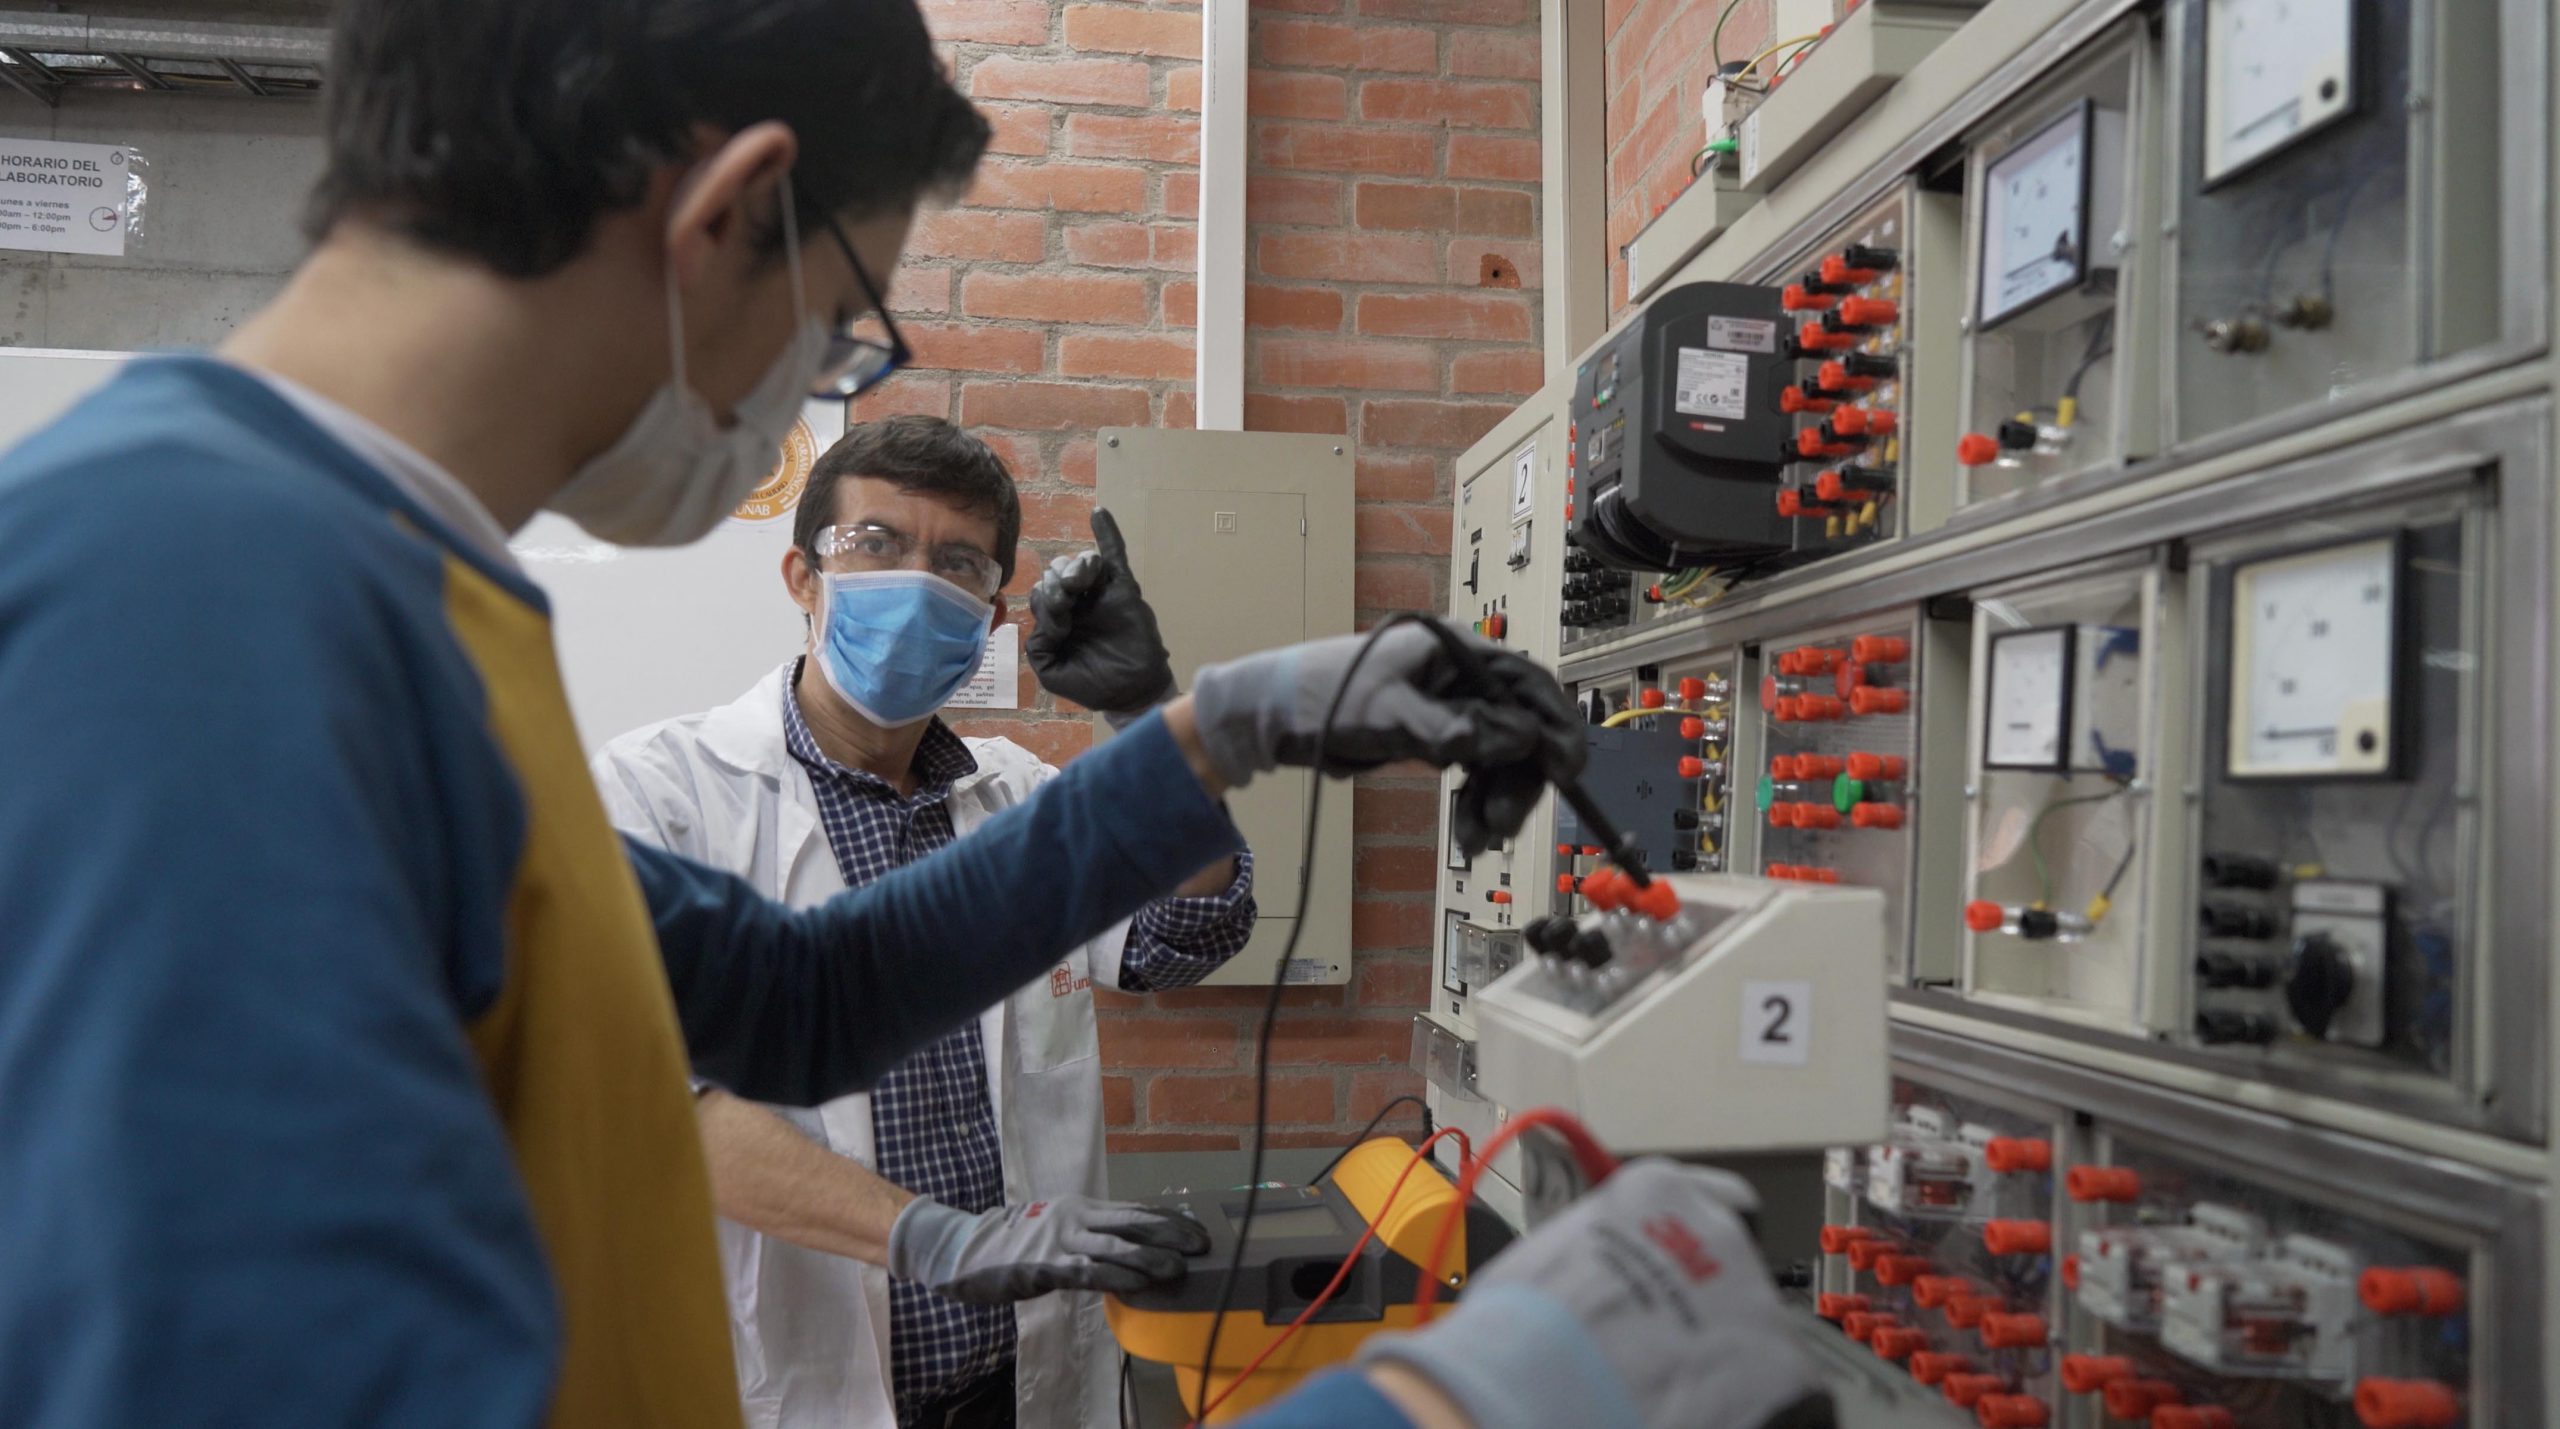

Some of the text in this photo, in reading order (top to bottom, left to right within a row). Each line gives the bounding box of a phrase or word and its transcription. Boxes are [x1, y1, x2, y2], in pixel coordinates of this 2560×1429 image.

[1, 154, 101, 172] HORARIO DEL
[0, 198, 23, 206] unes
[35, 200, 70, 209] viernes
[1518, 462, 1529, 505] 2
[735, 503, 770, 516] UNAB
[1761, 995, 1791, 1043] 2
